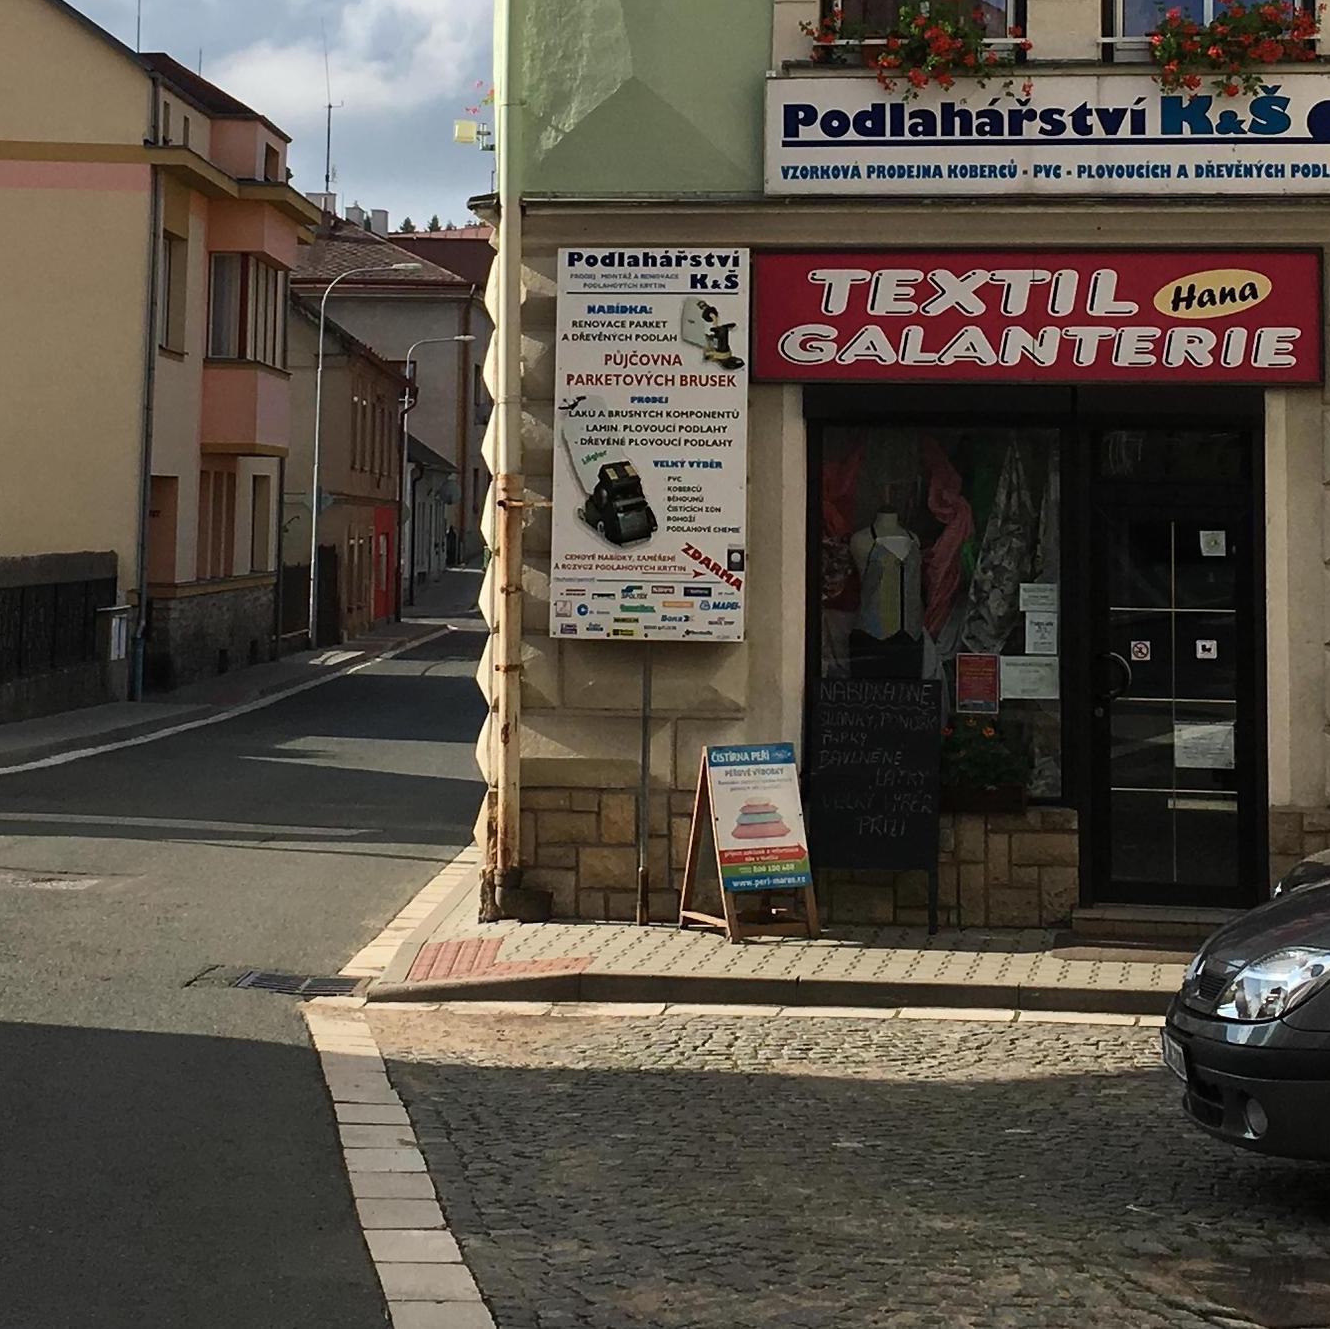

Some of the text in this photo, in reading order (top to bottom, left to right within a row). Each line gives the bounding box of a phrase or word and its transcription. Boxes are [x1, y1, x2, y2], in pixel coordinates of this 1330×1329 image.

[783, 84, 1292, 138] Podlahářství K&Š
[781, 161, 862, 179] VZORKOVÁ
[867, 164, 943, 179] PRODEJNA
[947, 159, 1018, 179] KOBERCŮ
[1033, 164, 1062, 179] PVC
[1077, 160, 1171, 179] PLOVOUCÍCH
[1176, 163, 1189, 178] A
[1194, 159, 1286, 179] DŘEVĚNÝCH
[567, 250, 740, 267] Podlahářství
[807, 269, 1260, 317] TEXTIL Hana
[587, 302, 653, 315] NABÍDKA:
[571, 320, 668, 329] RENOVACE PARKET
[561, 331, 678, 342] A DŘEVĚNÝCH PODLAH
[777, 323, 1302, 368] GALANTERIE
[604, 350, 683, 369] PŮJČOVNA
[566, 371, 737, 388] PARKETOVÝCH BRUSEK
[630, 396, 669, 404] PRODEJ
[597, 410, 606, 418] A
[622, 423, 676, 434] PLOVOUCÍ
[678, 425, 729, 434] PODLAHY
[628, 436, 682, 446] PLOVOUCÍ
[683, 438, 733, 447] PODLAHY
[680, 541, 743, 592] ZDARMA
